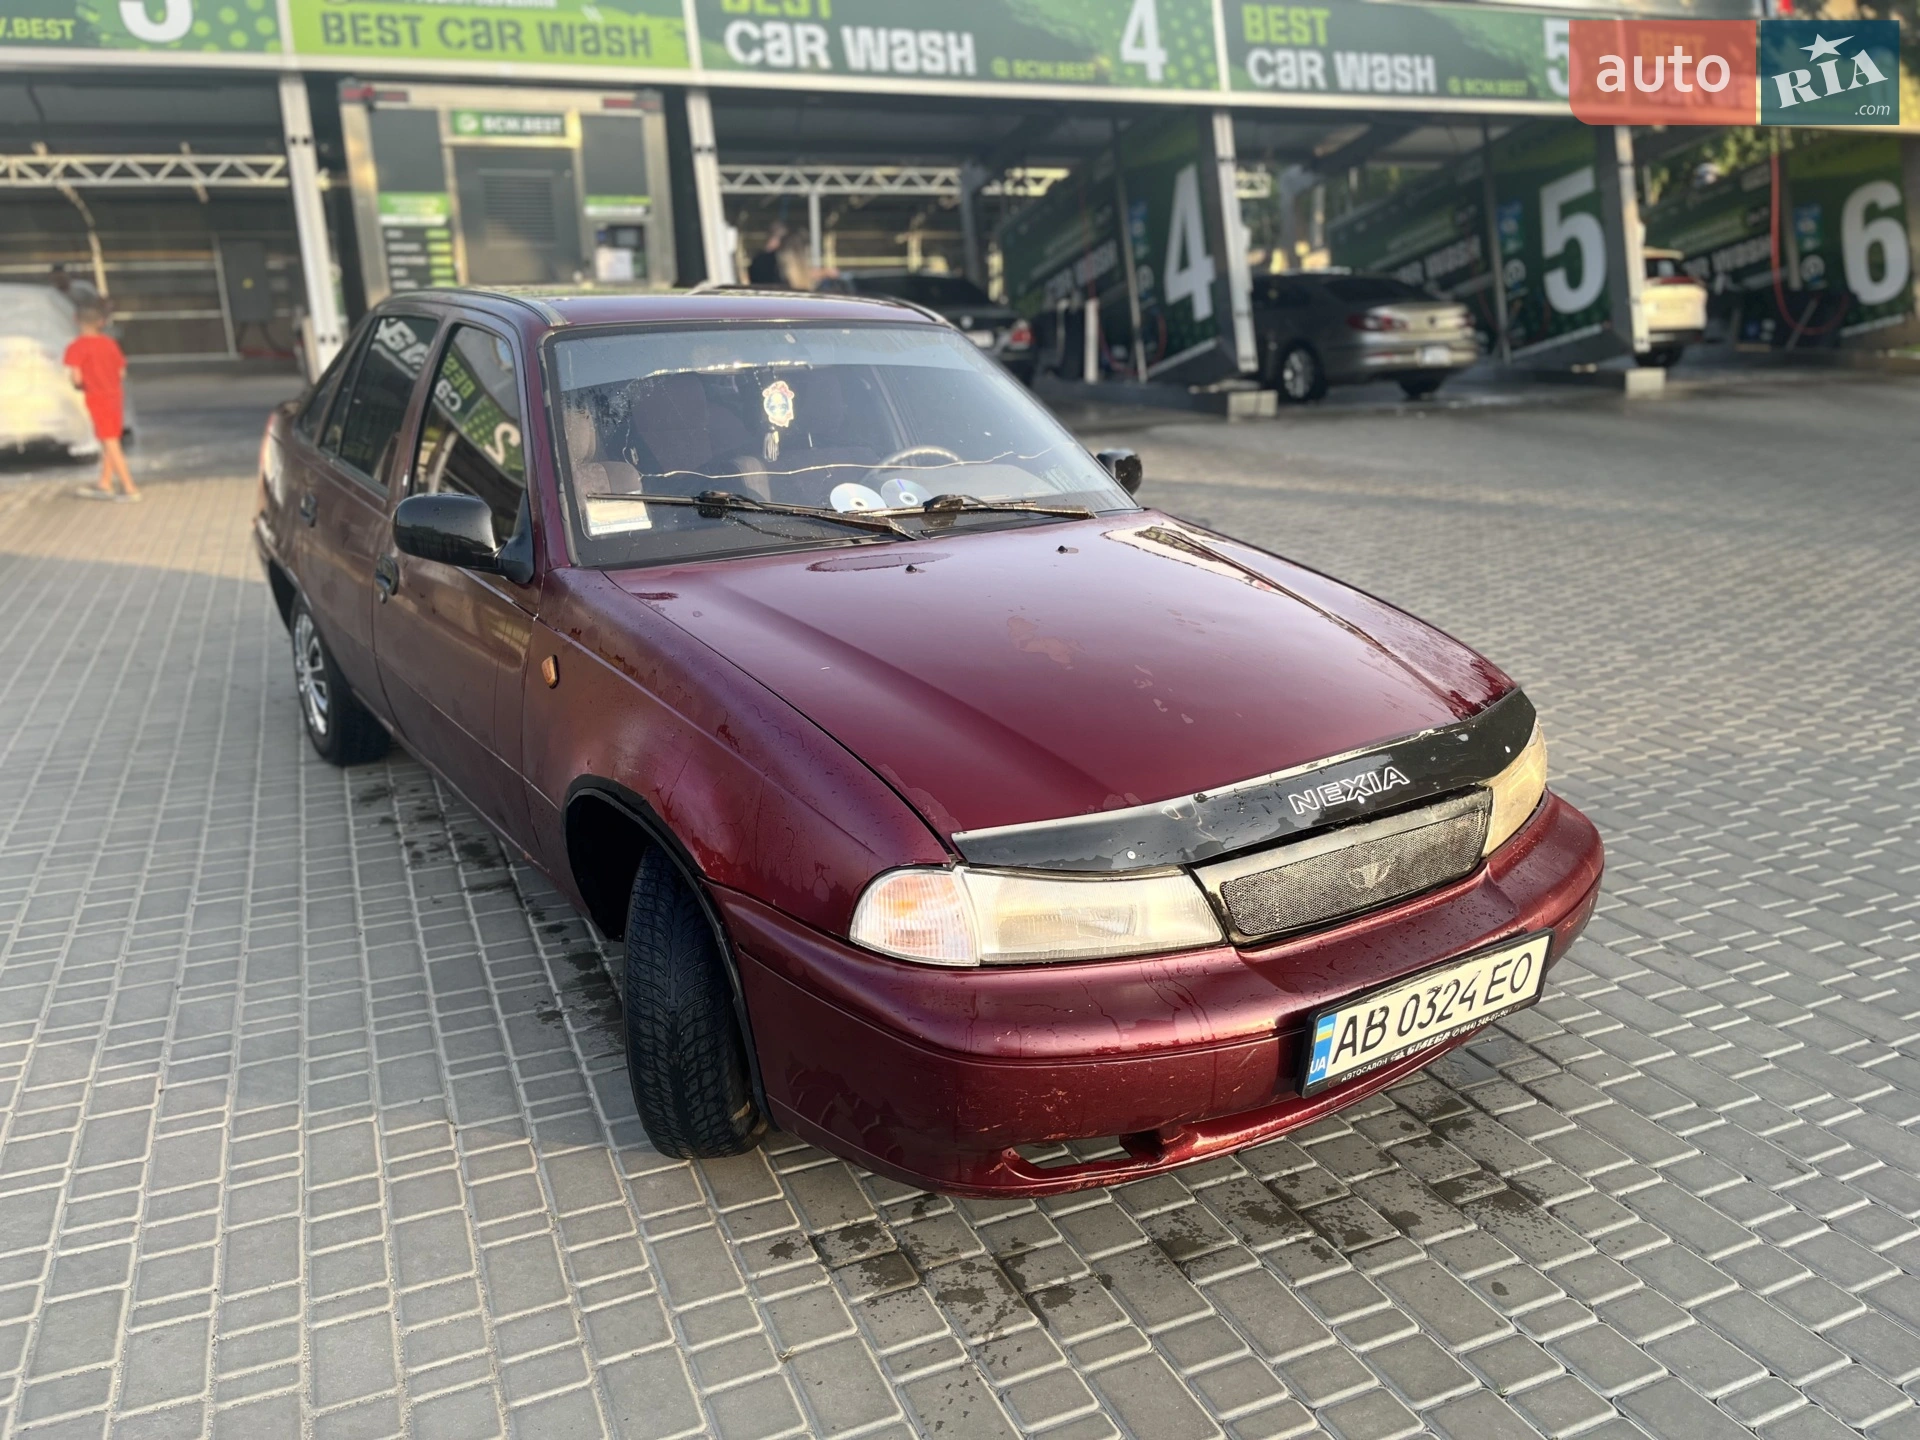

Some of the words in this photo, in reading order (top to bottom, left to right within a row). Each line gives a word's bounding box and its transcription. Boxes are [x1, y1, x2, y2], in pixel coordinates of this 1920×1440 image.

[320, 11, 423, 48] BEST
[1120, 0, 1167, 81] 4
[1242, 4, 1330, 46] BEST
[1164, 163, 1217, 322] 4
[1540, 165, 1607, 315] 5
[1841, 179, 1910, 306] 6
[1288, 765, 1411, 815] NEXIA
[1332, 1005, 1390, 1065] AB
[1397, 970, 1482, 1037] 0324
[1483, 952, 1532, 1006] EO
[1310, 1059, 1327, 1074] UA
